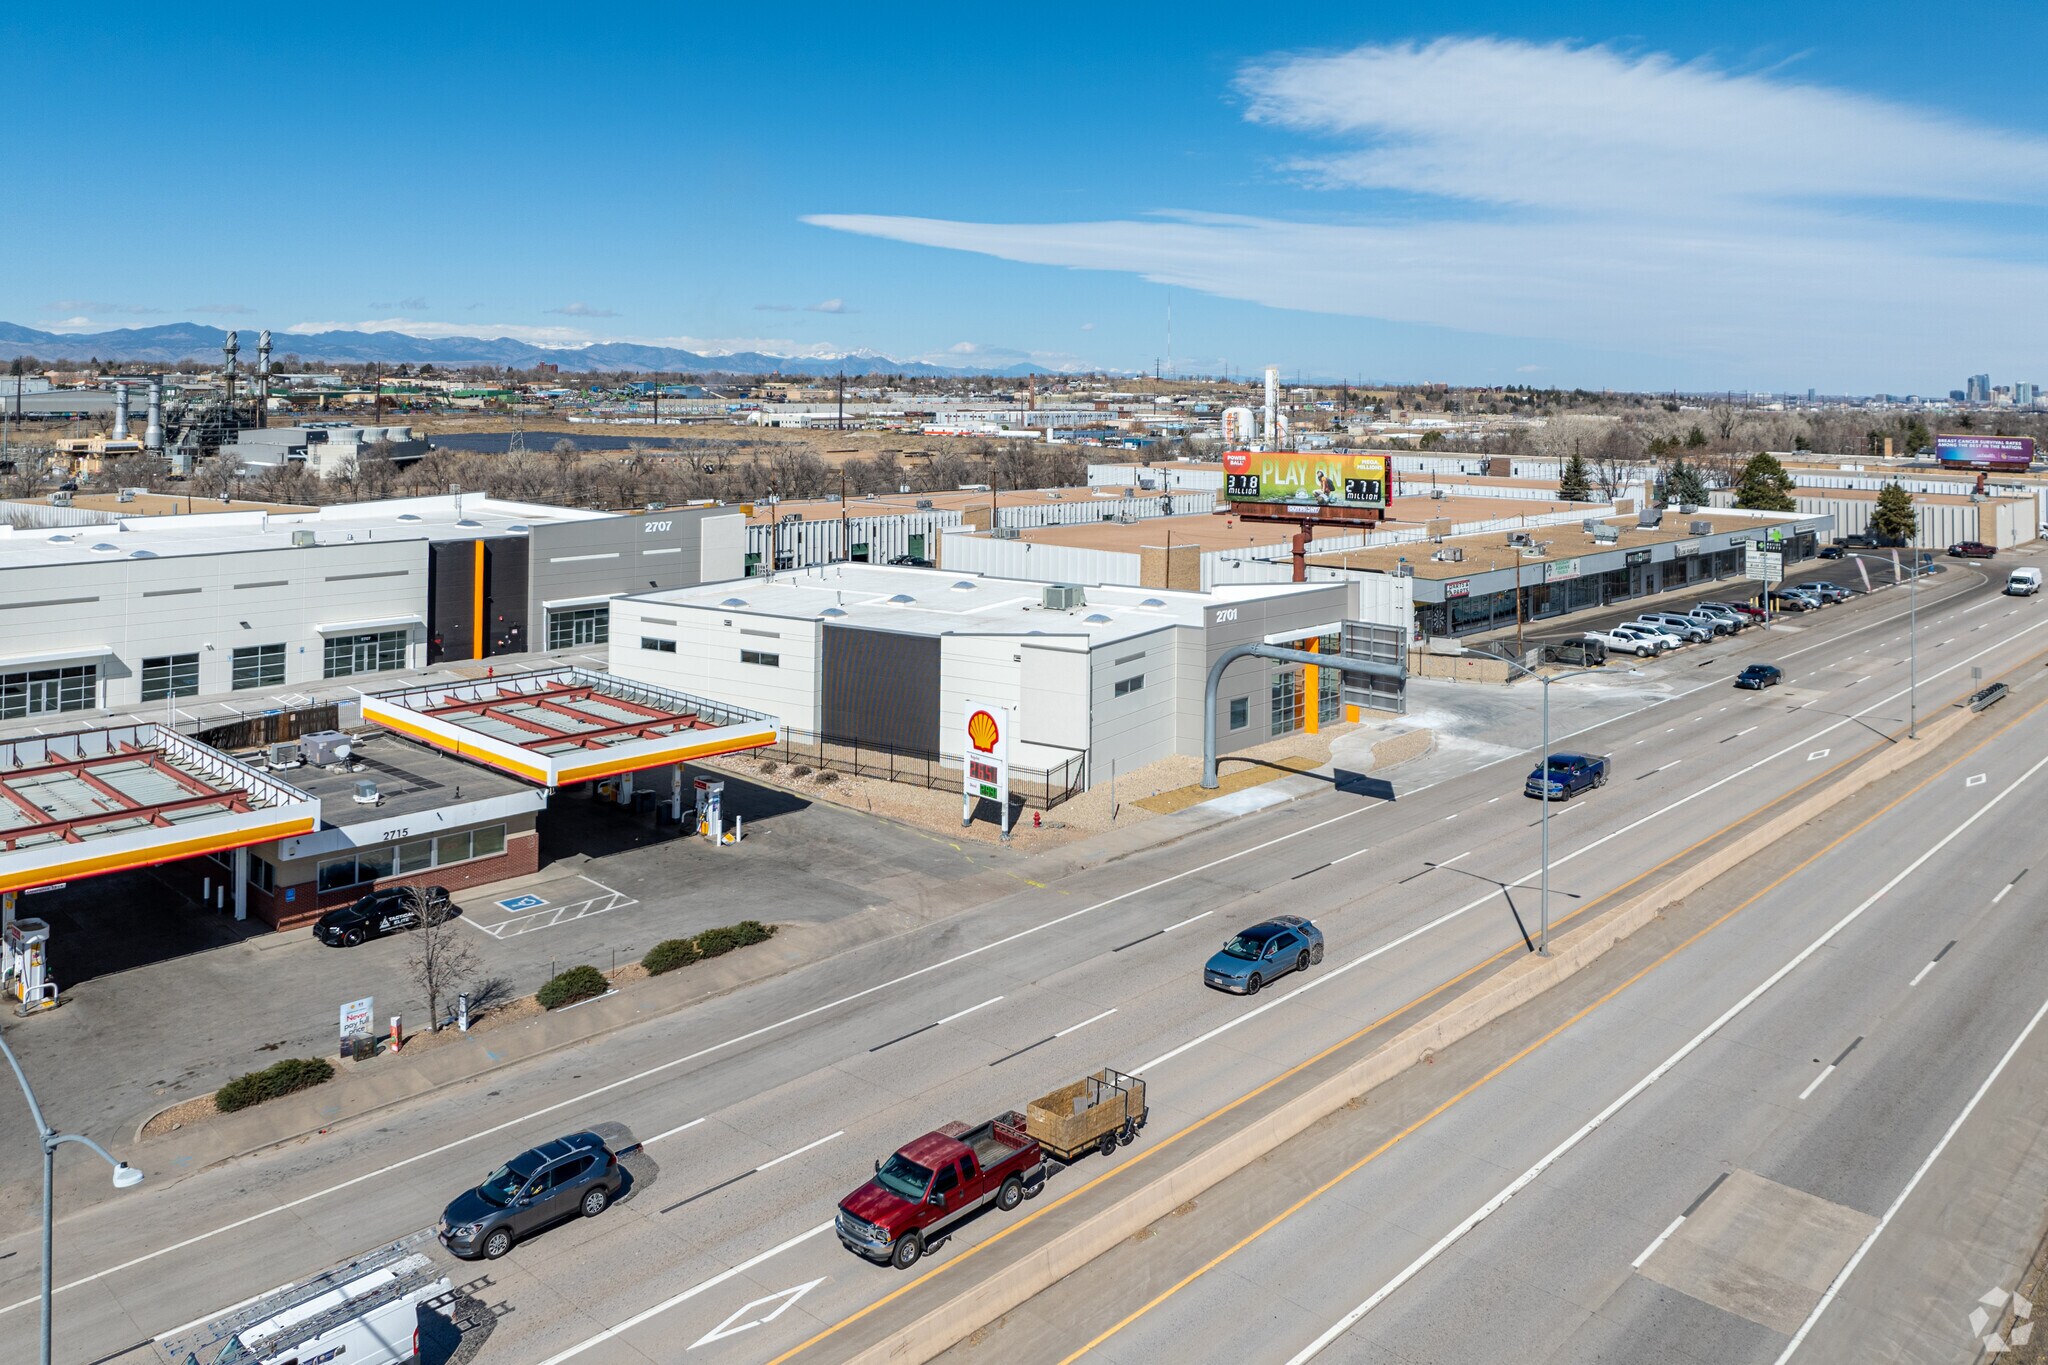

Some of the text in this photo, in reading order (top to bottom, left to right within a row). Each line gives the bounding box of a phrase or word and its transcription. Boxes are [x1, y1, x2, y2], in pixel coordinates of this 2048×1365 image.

[1262, 460, 1342, 487] PLAY ON
[1347, 492, 1378, 500] MILLION
[645, 521, 672, 532] 2707
[1216, 608, 1238, 623] 2701
[384, 828, 409, 840] 2715
[388, 912, 414, 921] TACTICAL
[347, 1012, 368, 1022] Never
[344, 1016, 369, 1031] pay full
[349, 1027, 365, 1036] price
